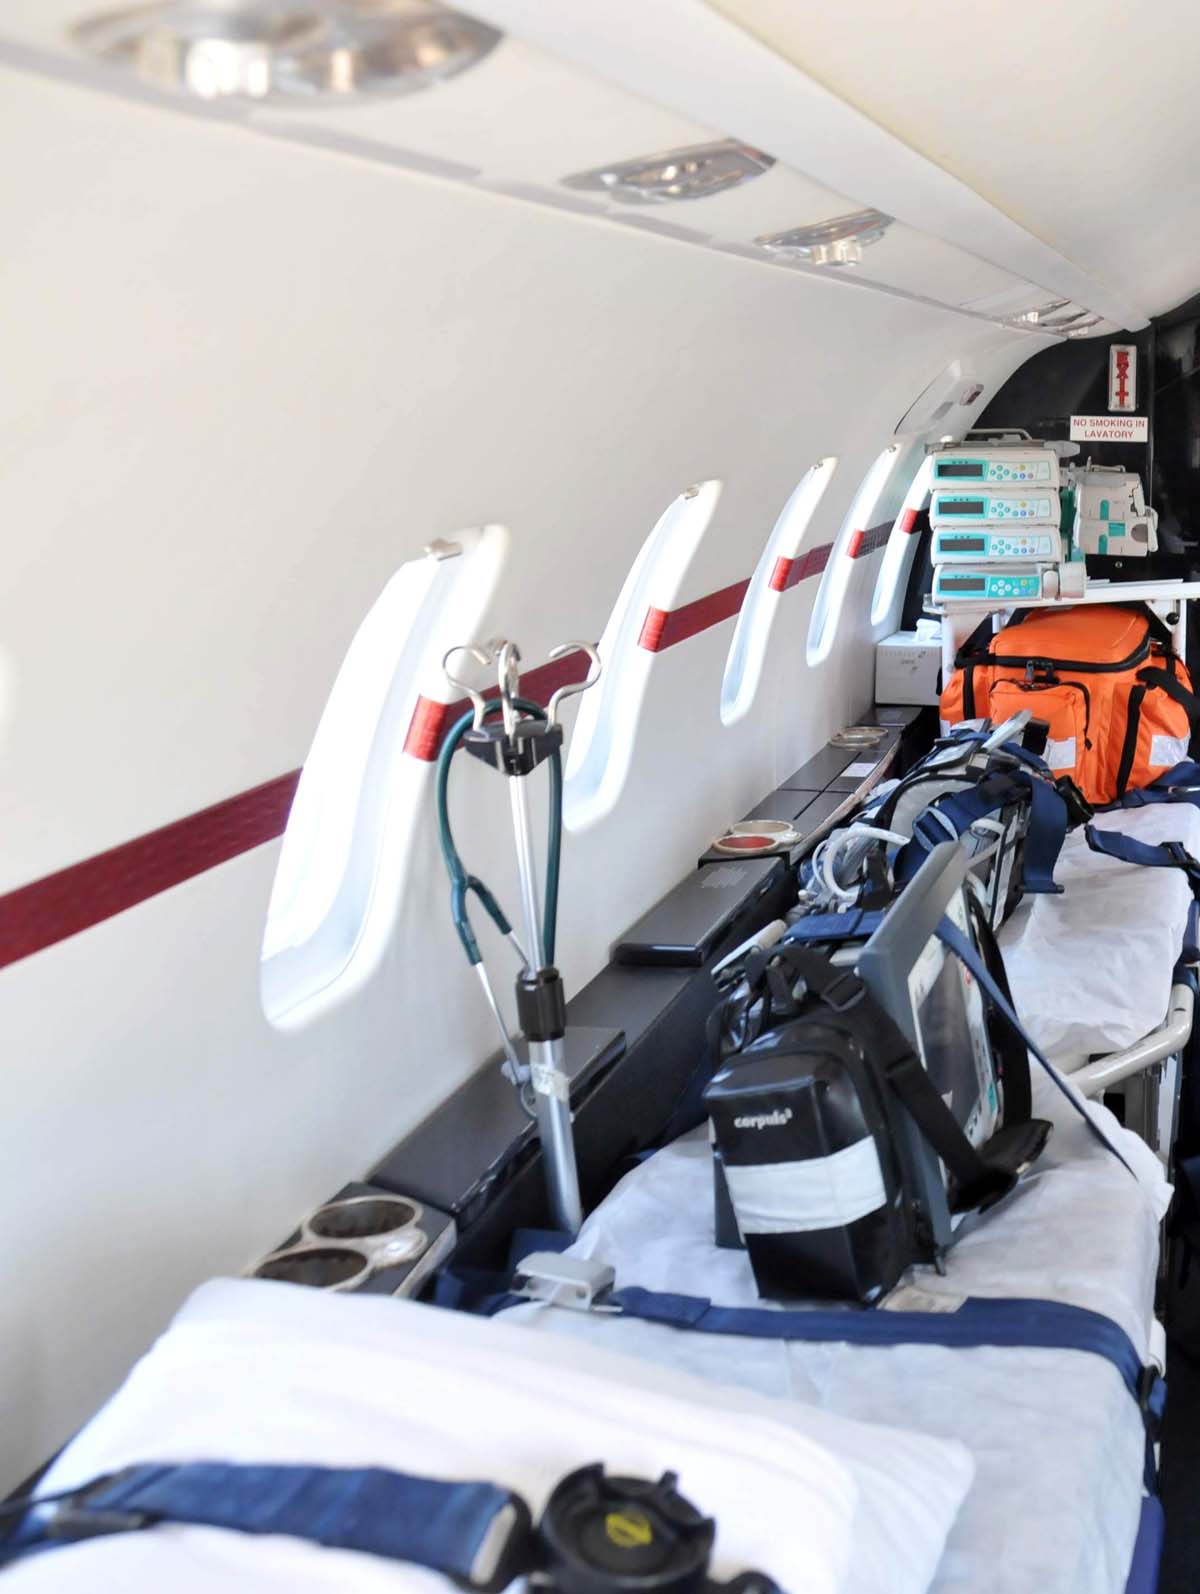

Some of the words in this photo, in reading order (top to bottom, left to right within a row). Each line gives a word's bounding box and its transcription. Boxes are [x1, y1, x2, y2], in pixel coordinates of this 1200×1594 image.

[1115, 351, 1129, 407] EXIT
[1073, 418, 1087, 427] NO
[1089, 419, 1133, 427] SMOKING
[1135, 419, 1145, 428] IN
[1084, 430, 1134, 438] LAVATORY
